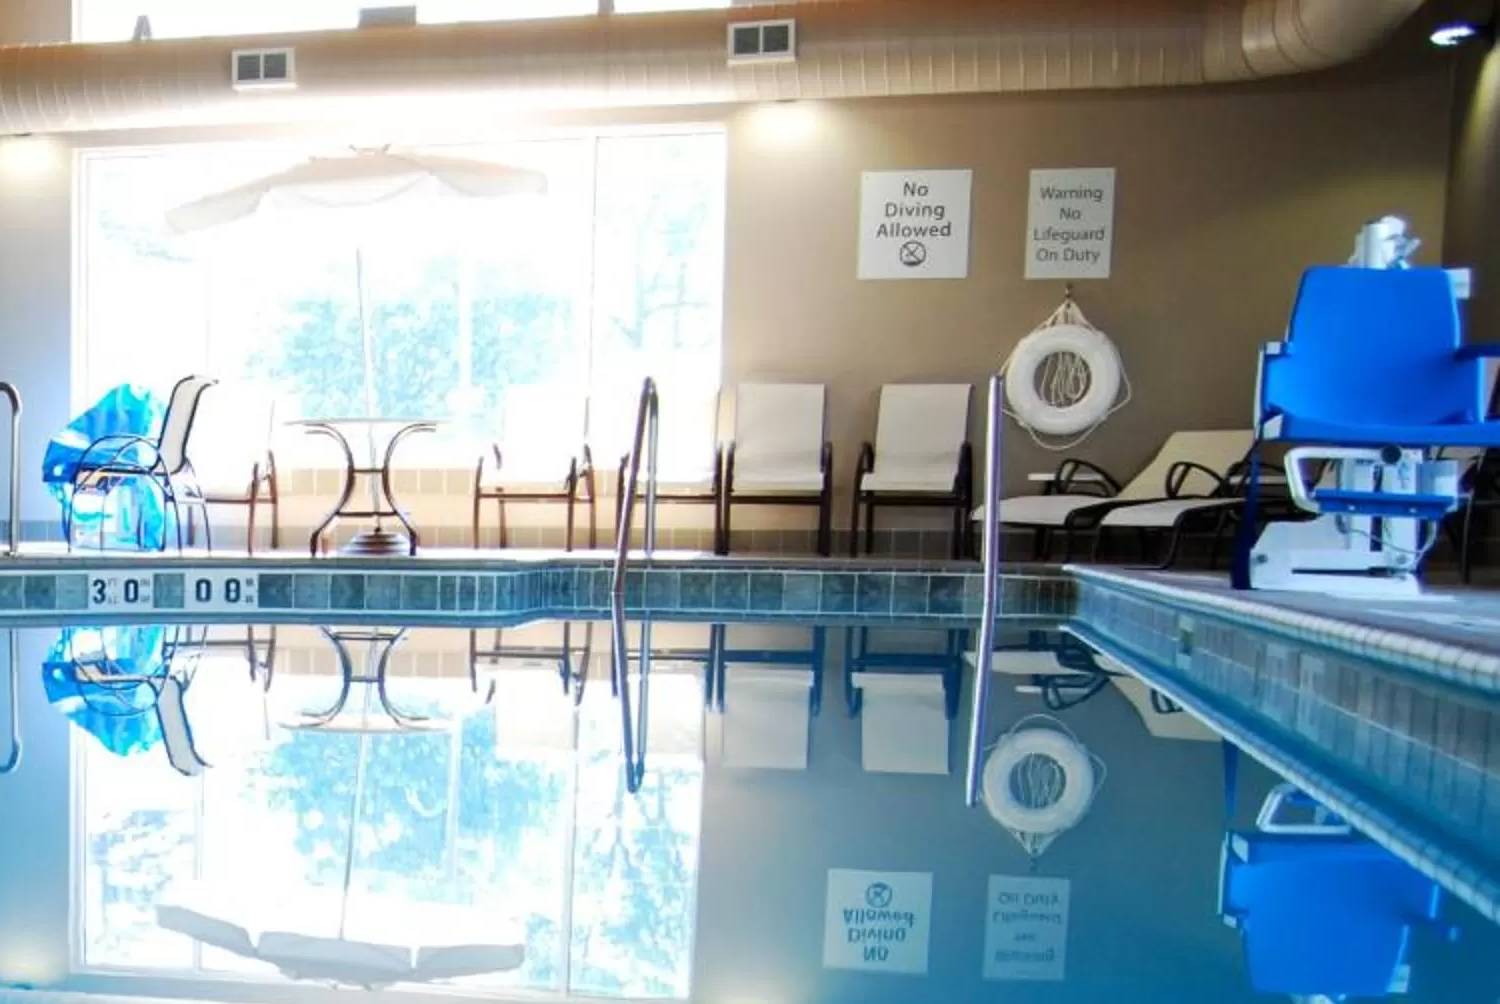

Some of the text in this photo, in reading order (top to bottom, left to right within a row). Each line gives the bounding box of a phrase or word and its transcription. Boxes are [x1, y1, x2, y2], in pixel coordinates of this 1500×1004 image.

[903, 181, 929, 197] No
[1039, 186, 1104, 203] Warning
[884, 201, 946, 220] Diving
[1059, 207, 1081, 221] No
[876, 221, 952, 239] Allowed
[1033, 227, 1105, 245] Lifeguard
[1035, 247, 1101, 264] On Duty
